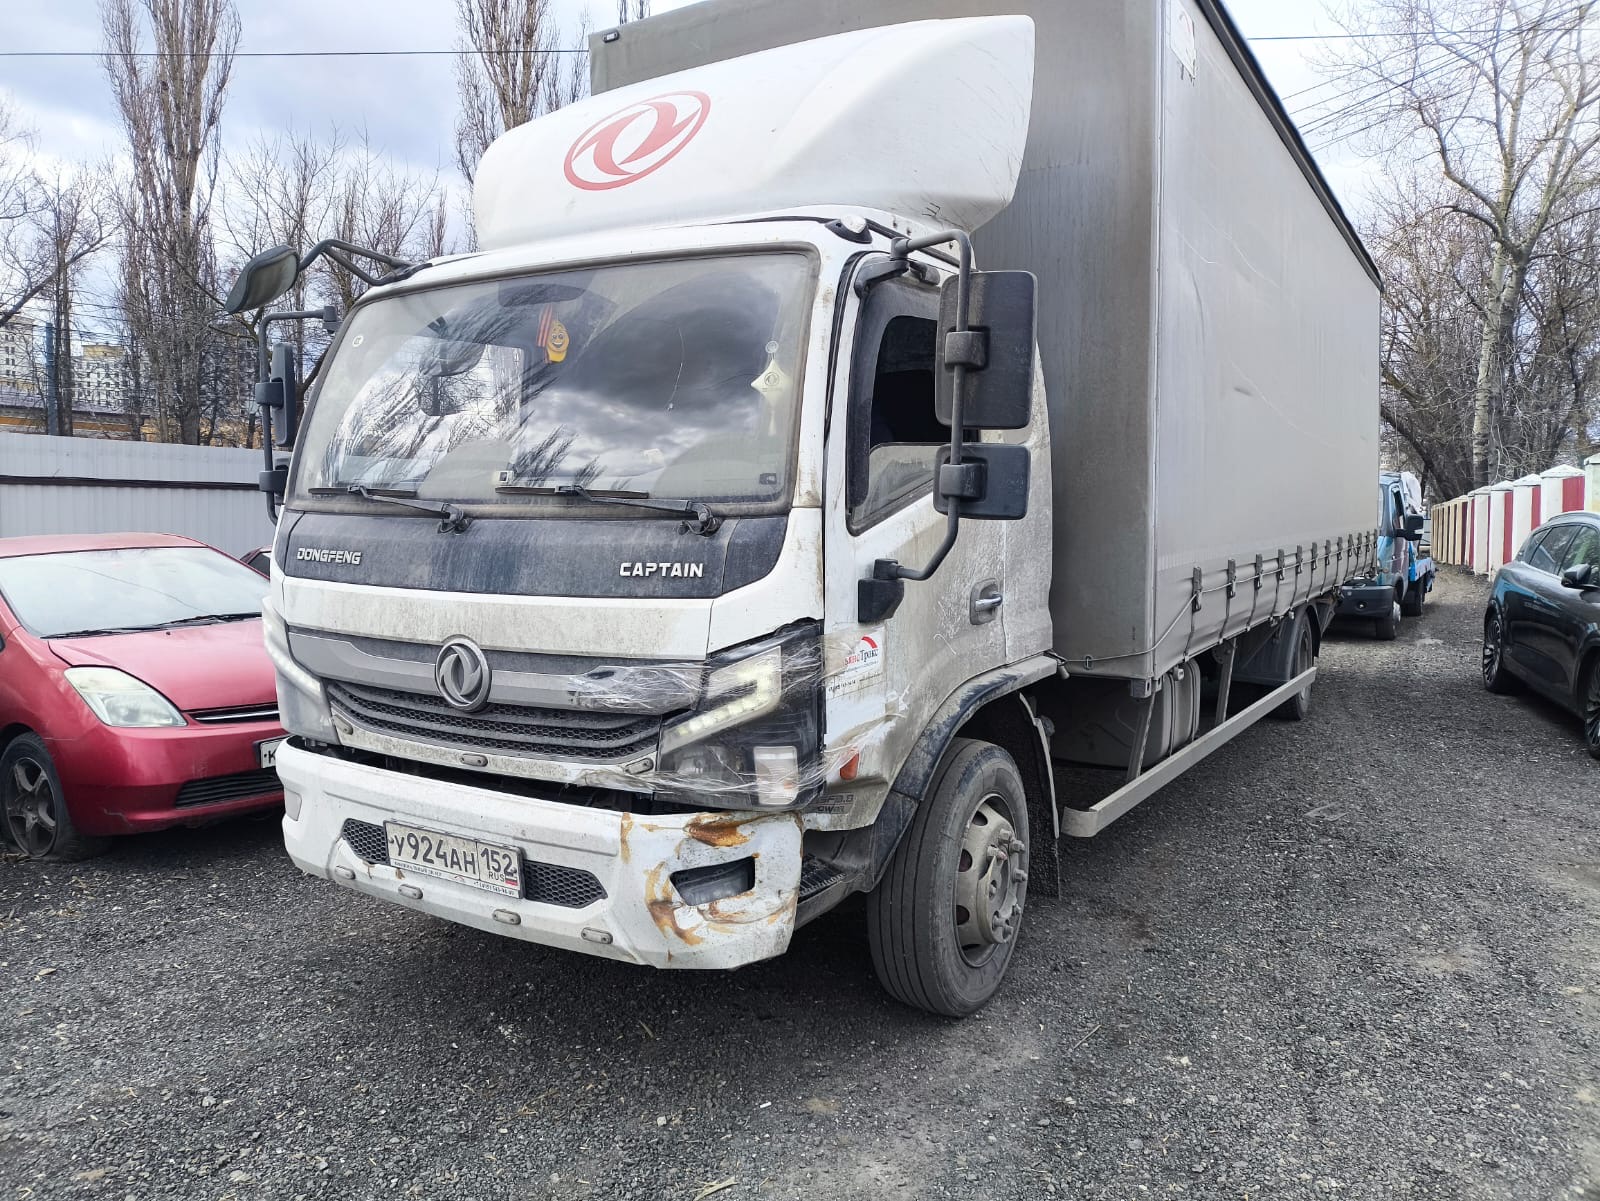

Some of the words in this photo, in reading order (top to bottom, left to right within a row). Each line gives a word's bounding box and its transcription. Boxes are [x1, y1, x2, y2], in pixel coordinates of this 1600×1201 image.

[297, 547, 362, 566] DONGFENG
[619, 561, 705, 578] CAPTAIN
[394, 832, 477, 875] У924АН
[481, 847, 515, 877] 152
[488, 870, 506, 883] RUS
